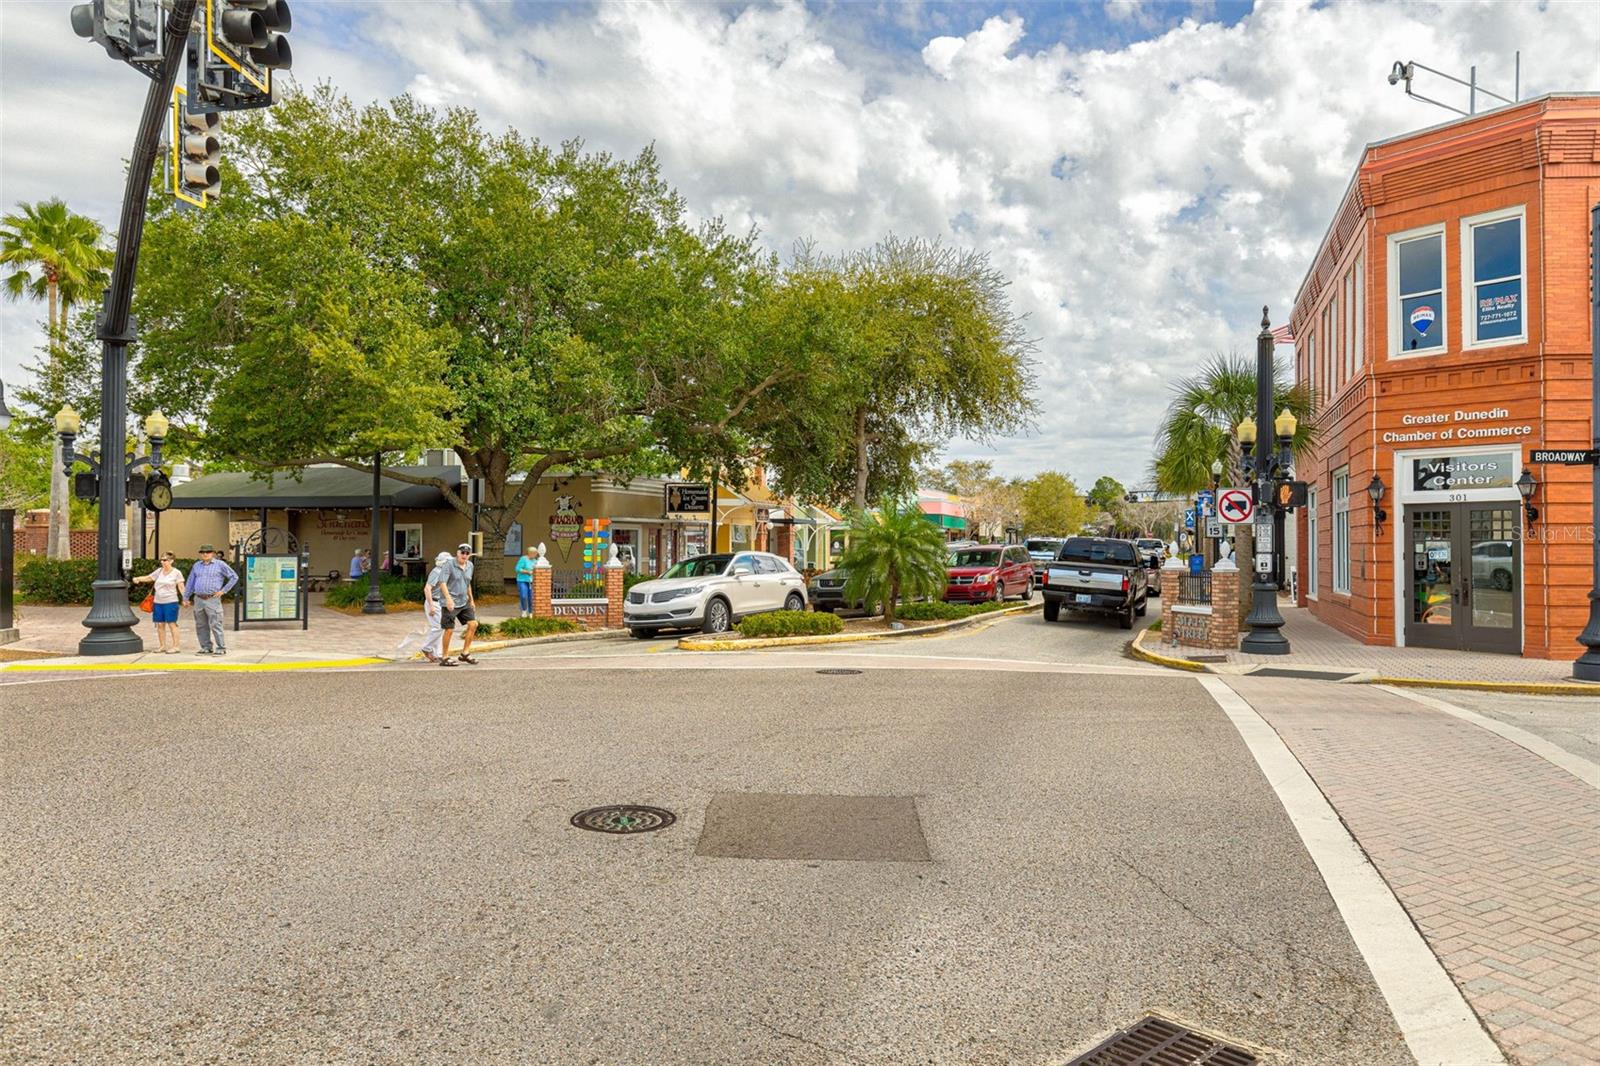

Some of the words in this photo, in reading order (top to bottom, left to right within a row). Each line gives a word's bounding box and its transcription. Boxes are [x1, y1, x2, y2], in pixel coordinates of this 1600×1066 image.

[1402, 412, 1450, 425] Greater
[1454, 407, 1509, 421] Dunedin
[1383, 430, 1437, 442] Chamber
[1440, 428, 1454, 440] of
[1457, 425, 1532, 438] Commerce
[1535, 452, 1586, 461] BROADWAY
[1428, 462, 1498, 473] Visitors
[1433, 475, 1494, 486] Center
[1449, 494, 1467, 502] 301
[1209, 528, 1220, 536] 15
[1429, 550, 1448, 559] OPEN
[553, 606, 607, 616] DUNEDIN
